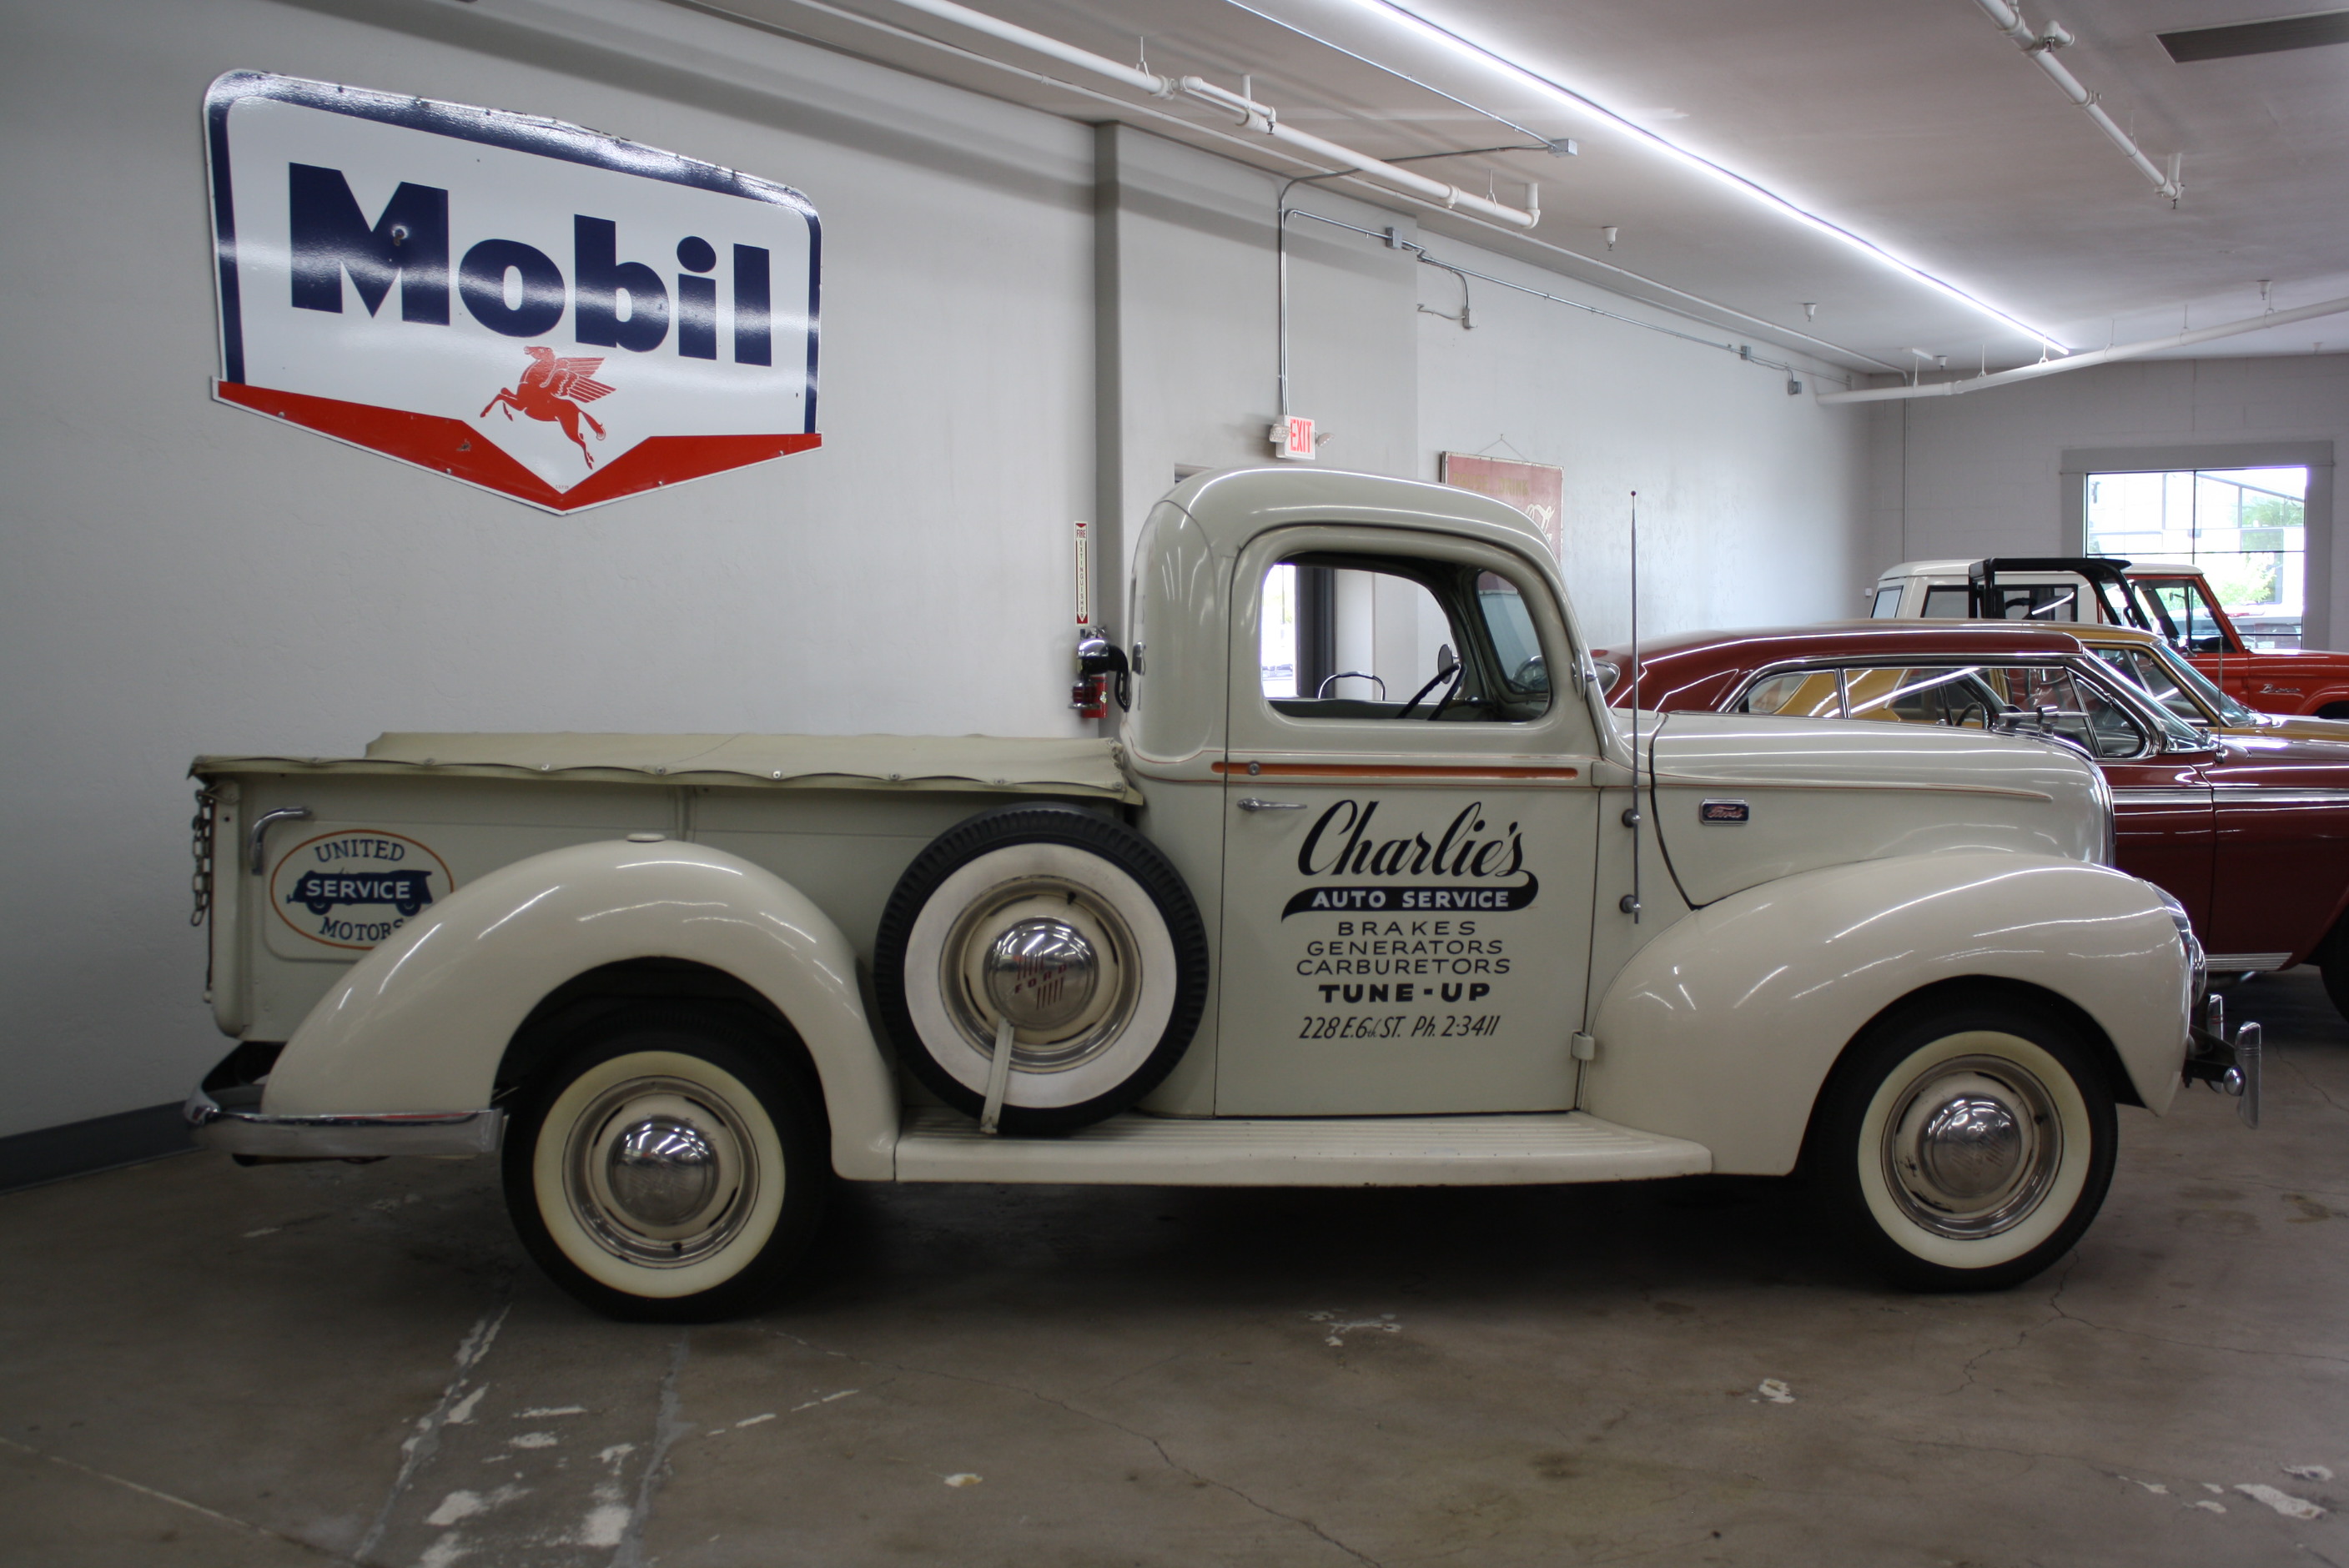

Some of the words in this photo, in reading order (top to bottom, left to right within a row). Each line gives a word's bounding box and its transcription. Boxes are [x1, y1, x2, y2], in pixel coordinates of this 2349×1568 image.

[289, 162, 772, 367] Mobil
[1290, 419, 1312, 453] EXIT
[1076, 529, 1086, 538] FIRE
[1707, 805, 1743, 818] Ford
[1297, 799, 1523, 877] Charlie's
[314, 839, 405, 863] UNITED
[305, 879, 410, 899] SERVICE
[1311, 890, 1386, 908] AUTO
[1401, 890, 1509, 908] SERVICE
[1337, 921, 1476, 937] BRAKES
[1306, 940, 1503, 956] GENERATORS
[1296, 958, 1511, 975] CARBURETORS
[1014, 963, 1068, 994] FORD
[1299, 1016, 1340, 1039] 228
[1411, 1015, 1436, 1038] Ph.
